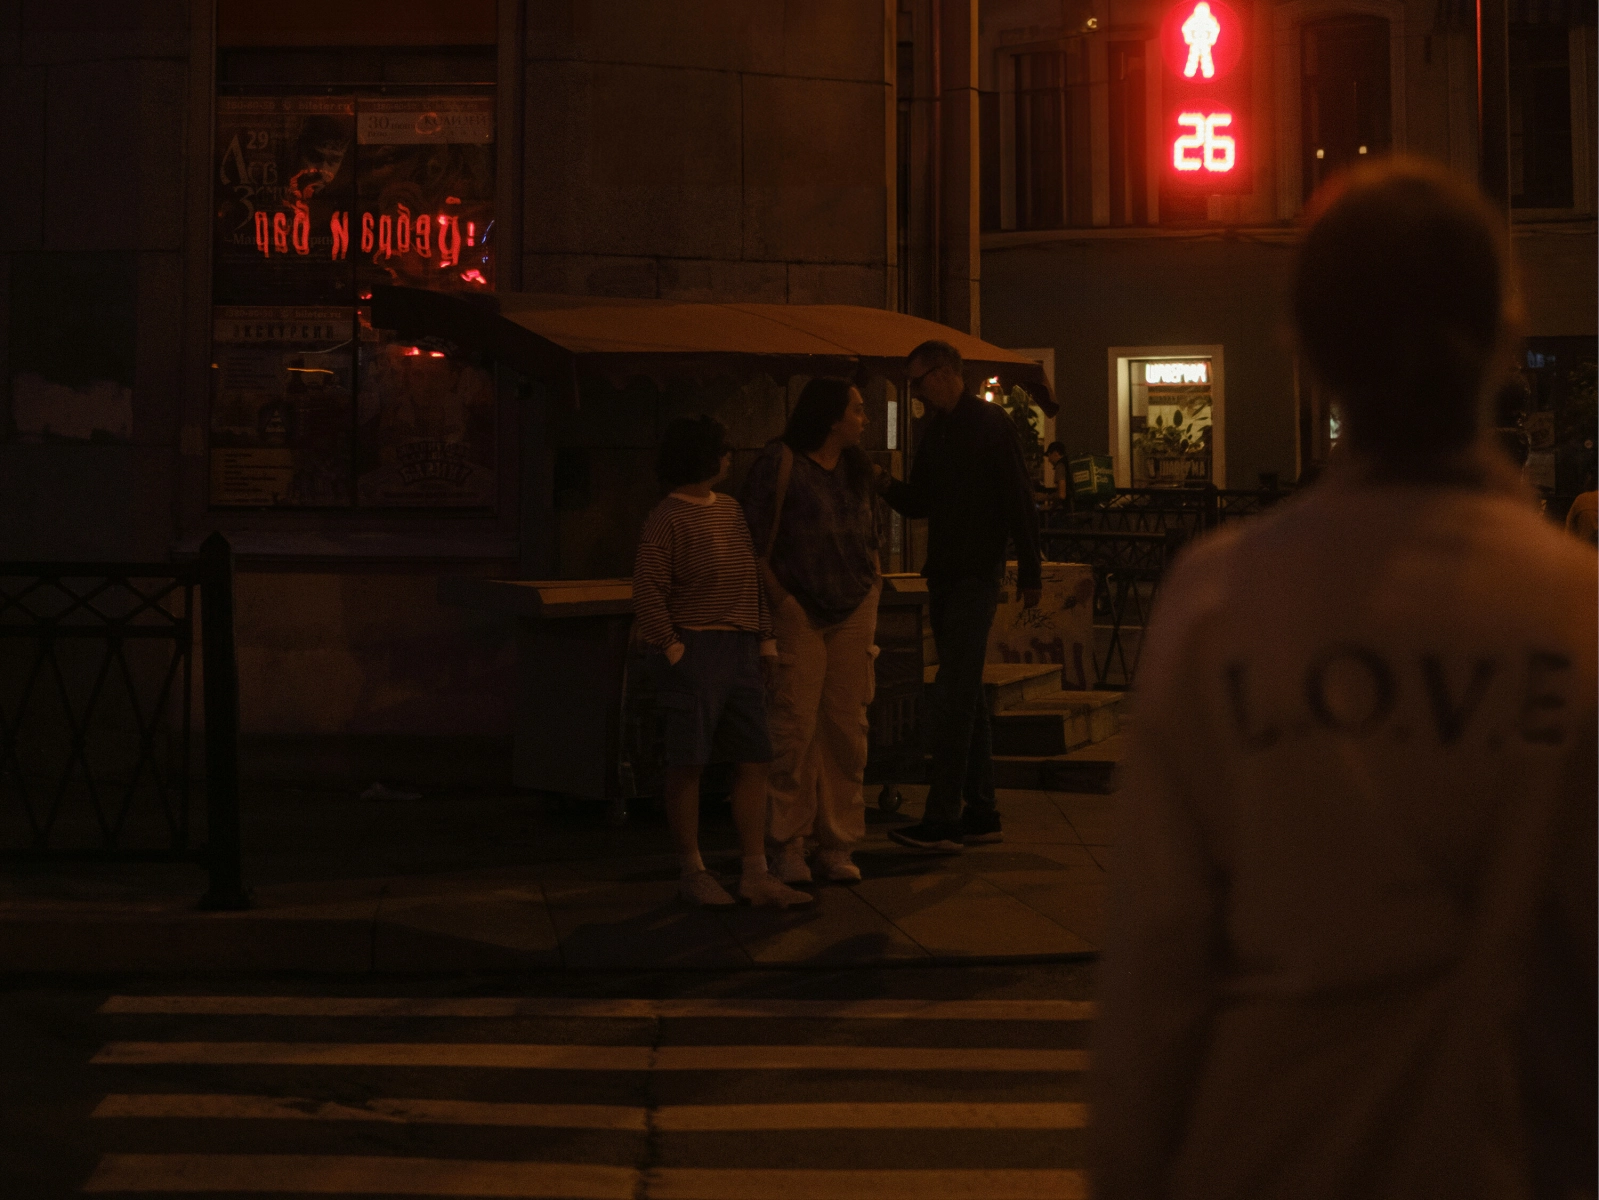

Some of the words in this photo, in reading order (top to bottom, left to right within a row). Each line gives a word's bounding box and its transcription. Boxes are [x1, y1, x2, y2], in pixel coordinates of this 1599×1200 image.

[368, 116, 390, 130] 30
[246, 130, 269, 150] 29
[1173, 113, 1235, 172] 26
